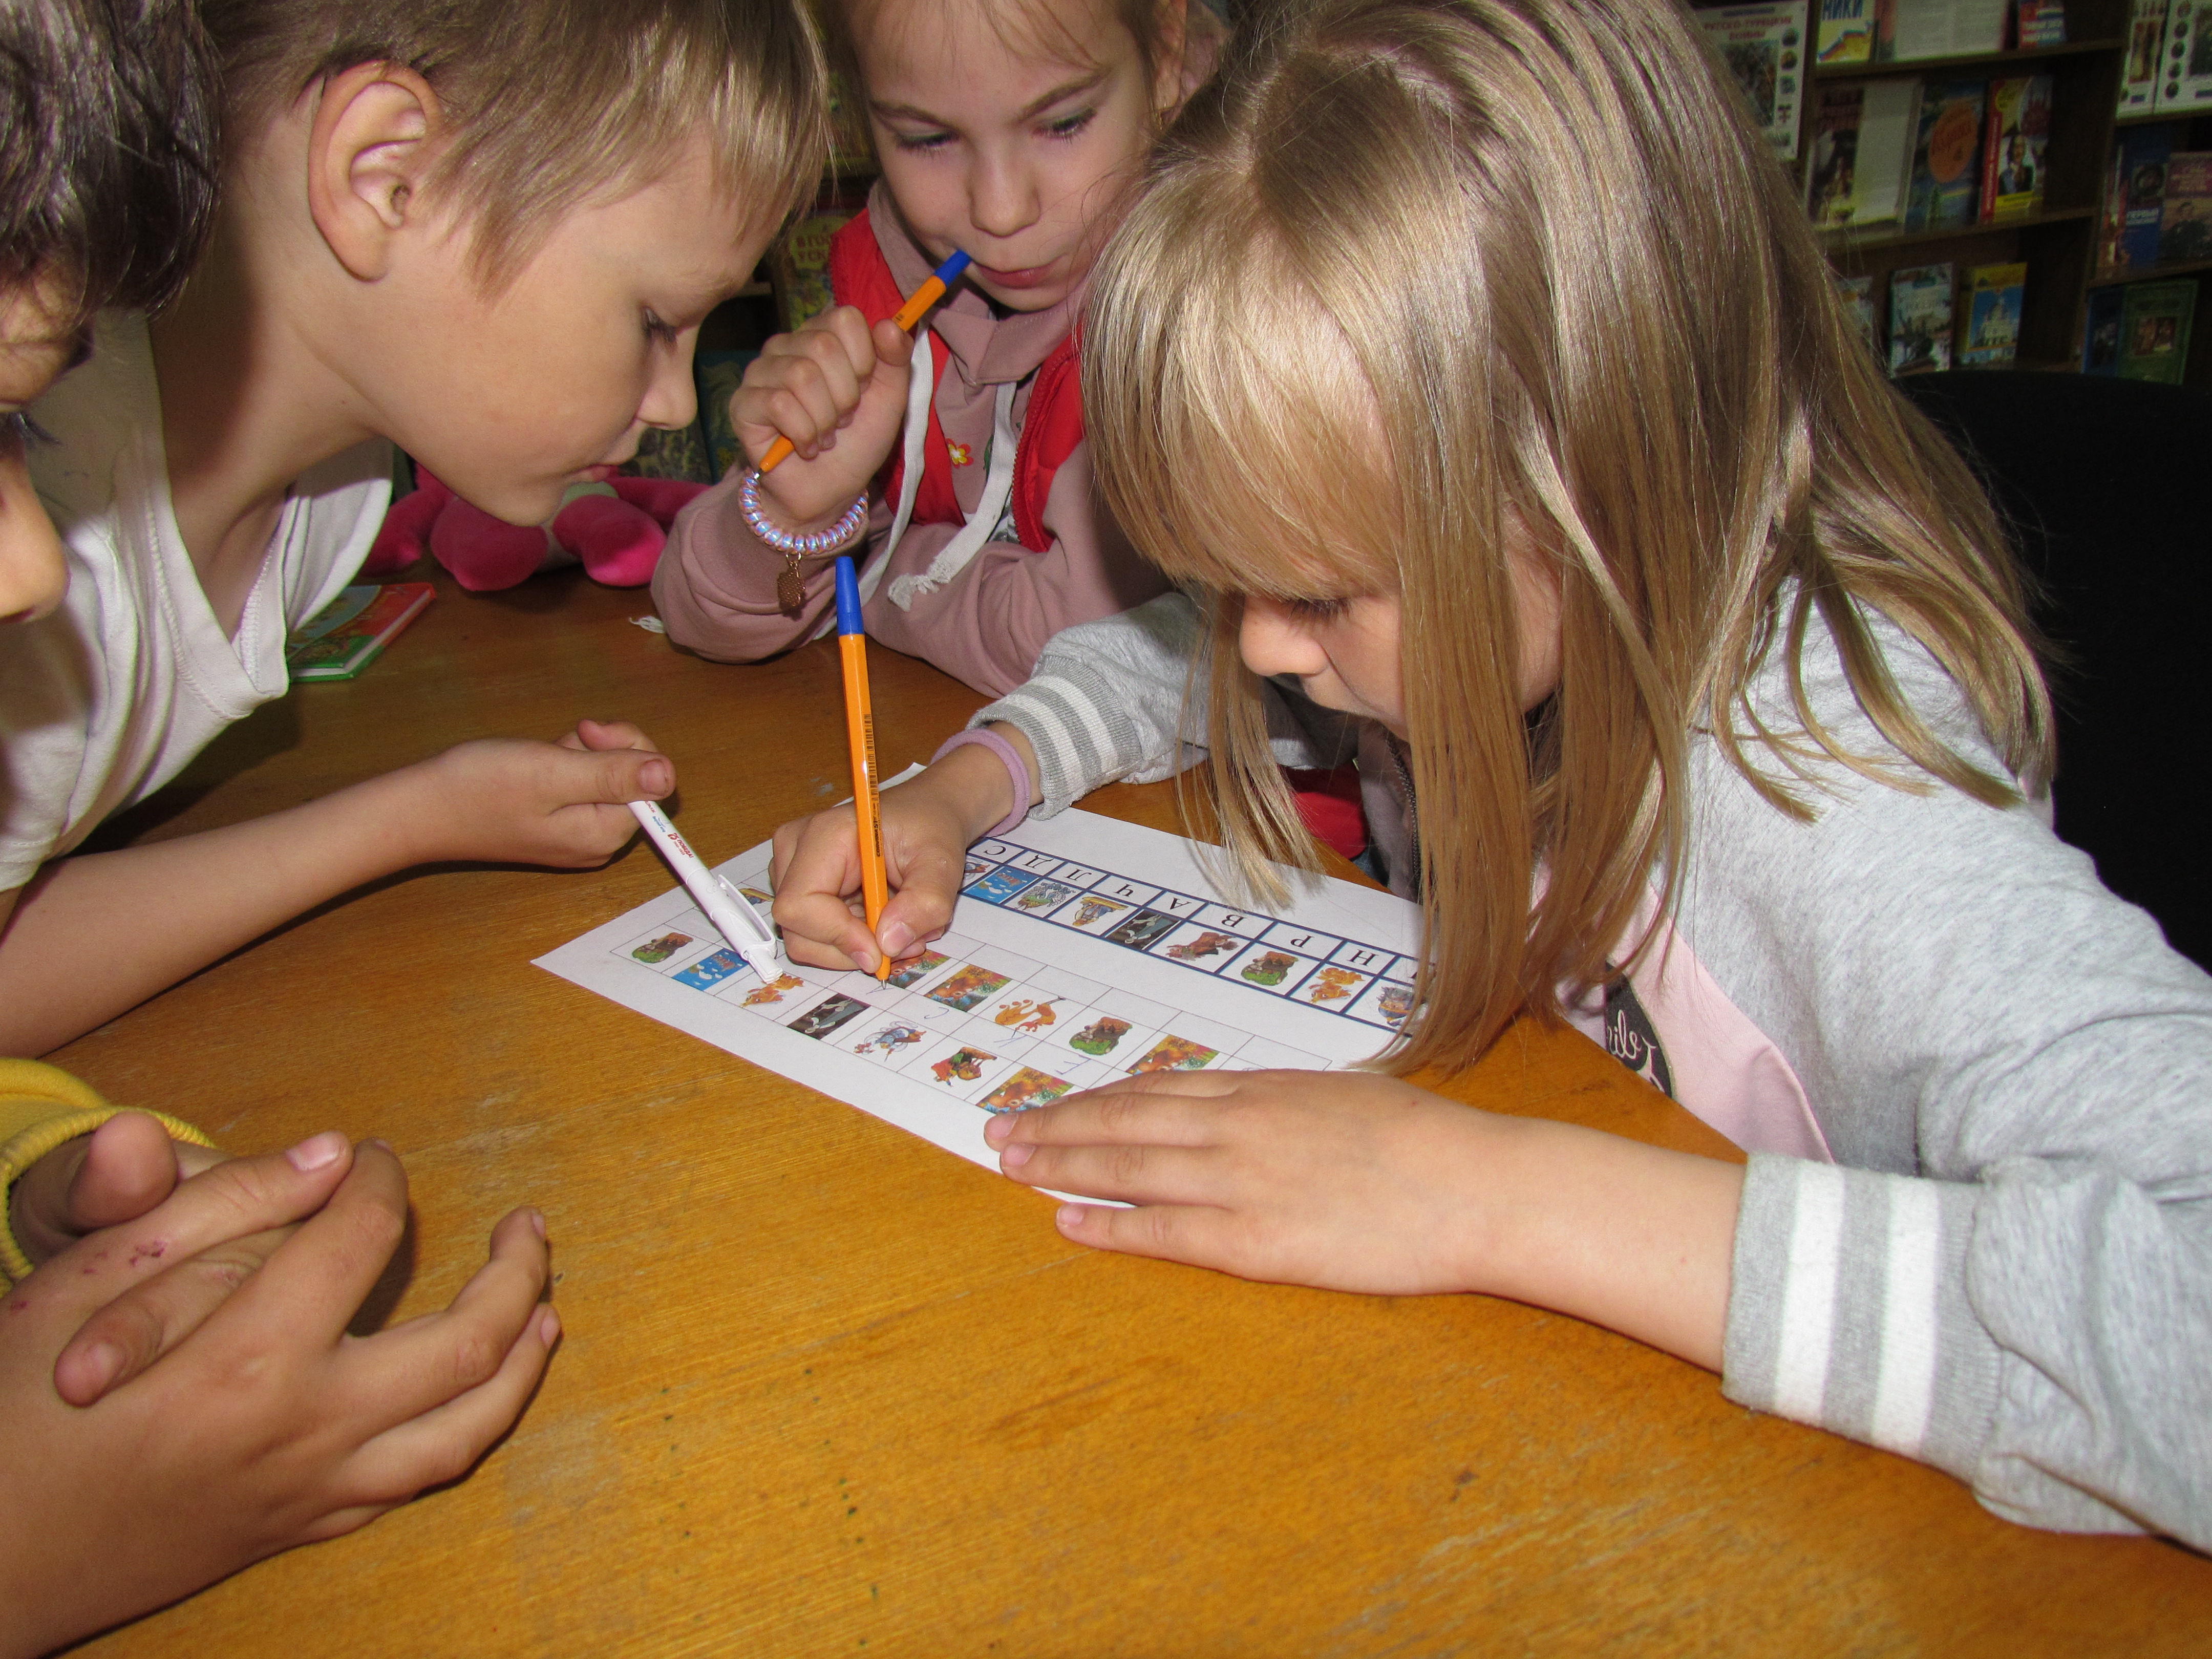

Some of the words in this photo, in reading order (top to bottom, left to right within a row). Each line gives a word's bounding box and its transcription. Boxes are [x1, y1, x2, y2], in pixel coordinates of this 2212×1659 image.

[677, 840, 694, 858] ПОБЕДА!
[983, 845, 1007, 855] С
[1022, 854, 1053, 868] Д
[1064, 868, 1092, 881] Л
[1115, 884, 1134, 897] Ч
[1168, 897, 1192, 910] А
[1221, 914, 1246, 927] В
[1290, 935, 1314, 948] Р
[1347, 950, 1378, 966] Н
